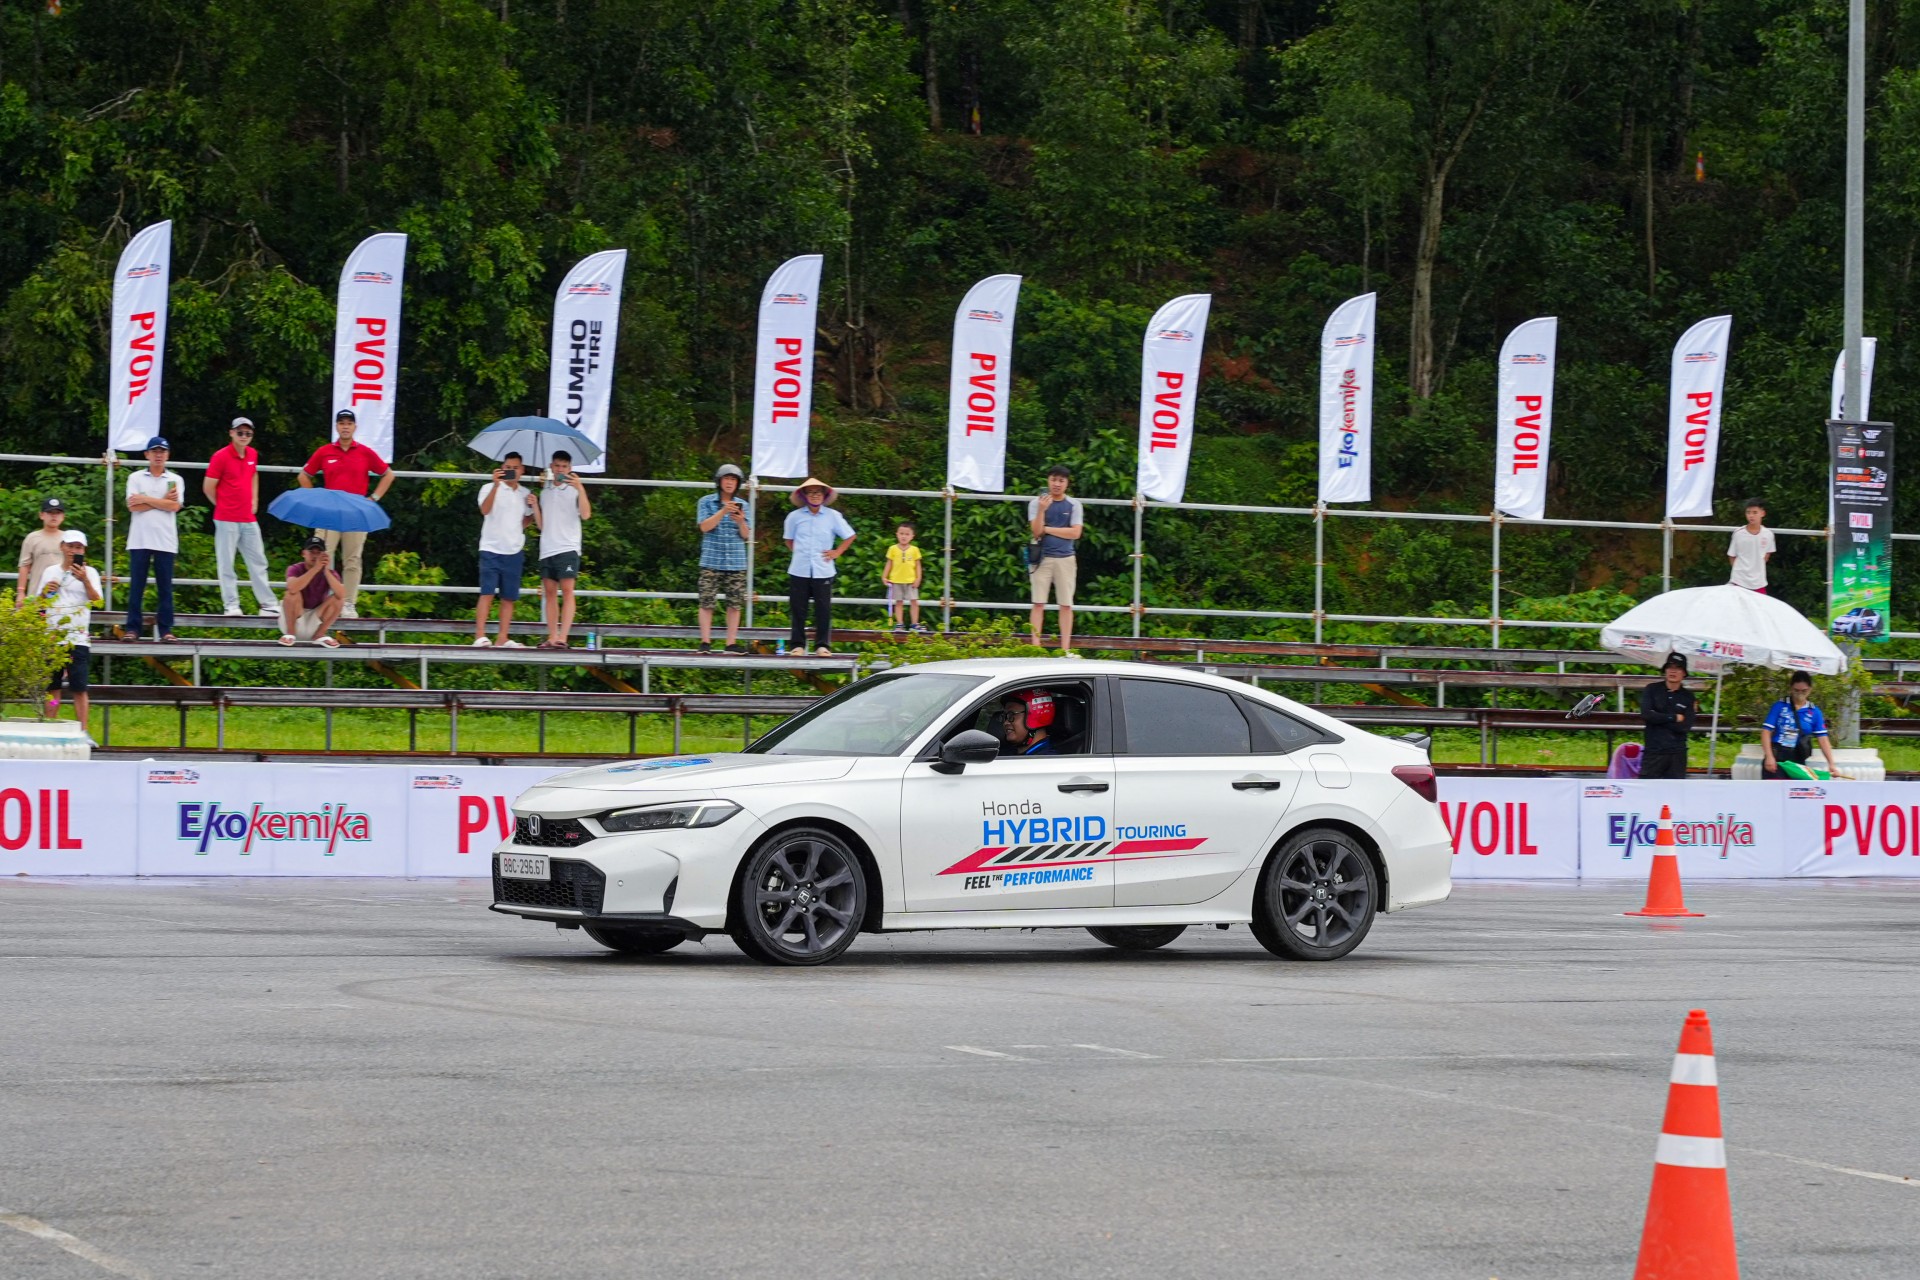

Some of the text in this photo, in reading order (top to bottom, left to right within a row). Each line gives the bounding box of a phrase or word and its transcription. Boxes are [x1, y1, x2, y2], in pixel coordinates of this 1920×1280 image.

[129, 311, 155, 404] PVOIL
[352, 317, 387, 406] PVOIL
[588, 320, 602, 374] TIRE
[771, 337, 803, 424] PVOIL
[966, 352, 997, 437] PVOIL
[1150, 370, 1185, 453] PVOIL
[1512, 395, 1543, 475] PVOIL
[1684, 391, 1713, 471] PVOIL
[1713, 641, 1744, 657] PVOIL
[179, 802, 371, 855] Ekokemika
[982, 799, 1042, 816] Honda
[983, 815, 1187, 846] HYBRID TOURING
[1608, 813, 1754, 859] Ekoemika
[964, 867, 1094, 890] FEEL THE PERFORMANCE
